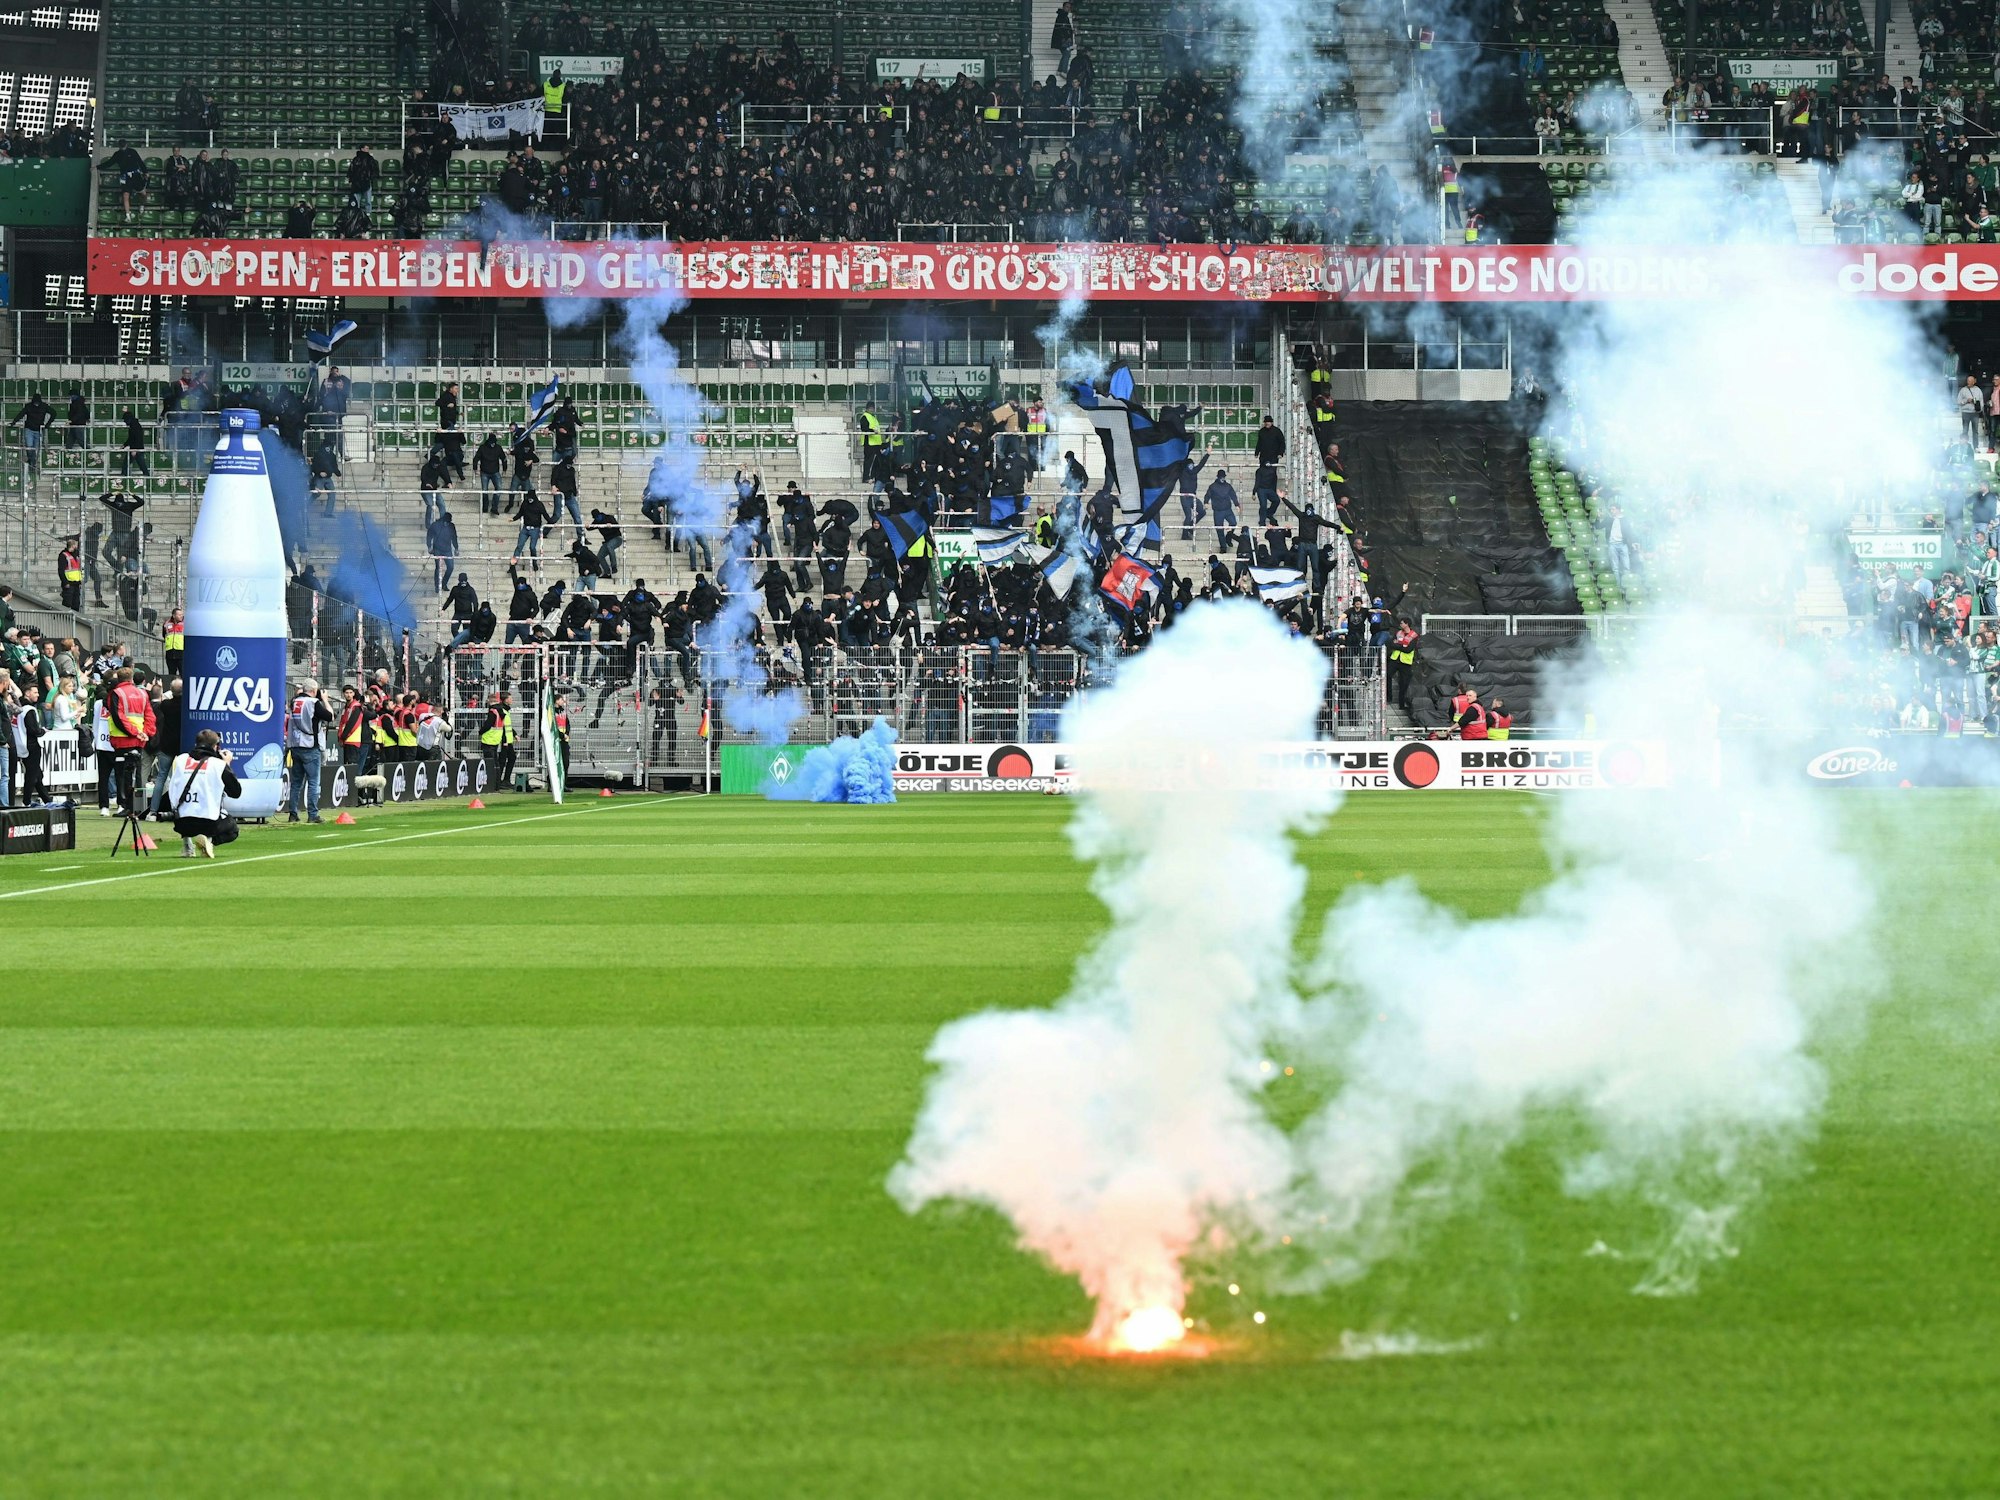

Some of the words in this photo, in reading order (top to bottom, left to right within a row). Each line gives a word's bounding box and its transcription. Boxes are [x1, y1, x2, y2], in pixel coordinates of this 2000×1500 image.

[880, 62, 900, 73] 117
[961, 63, 981, 74] 115
[1731, 64, 1752, 74] 113
[1815, 64, 1835, 74] 111
[1746, 79, 1819, 89] WSENHOF
[129, 250, 319, 292] SHOPPEN,
[332, 252, 491, 288] ERLEBEN
[503, 253, 586, 289] UND
[599, 253, 791, 290] GENIESSEN
[812, 254, 849, 290] IN
[863, 254, 934, 291] DER
[946, 245, 1137, 291] GRÖSSTEN
[1148, 256, 1441, 293] SHOPPGWELT
[1451, 257, 1518, 293] DES
[1838, 252, 1999, 292] dode
[225, 366, 252, 379] 120
[965, 370, 987, 382] 116
[911, 386, 982, 397] WSENHOF
[229, 416, 244, 426] bio
[939, 541, 962, 553] 114
[1912, 541, 1937, 554] 110
[1859, 561, 1934, 570] OLDSHMS
[198, 577, 259, 610] VILSA
[189, 676, 274, 723] VILSA
[189, 711, 230, 721] NATURFRISCH
[219, 731, 251, 744] ASSIC
[262, 751, 280, 767] bio
[891, 751, 982, 772] ÖTJE
[1258, 748, 1389, 769] RÖTJE
[1461, 747, 1593, 768] BRÖTJE
[950, 777, 1050, 792] sunseeker
[1461, 775, 1593, 787] HEIZUNG
[184, 793, 199, 804] 01
